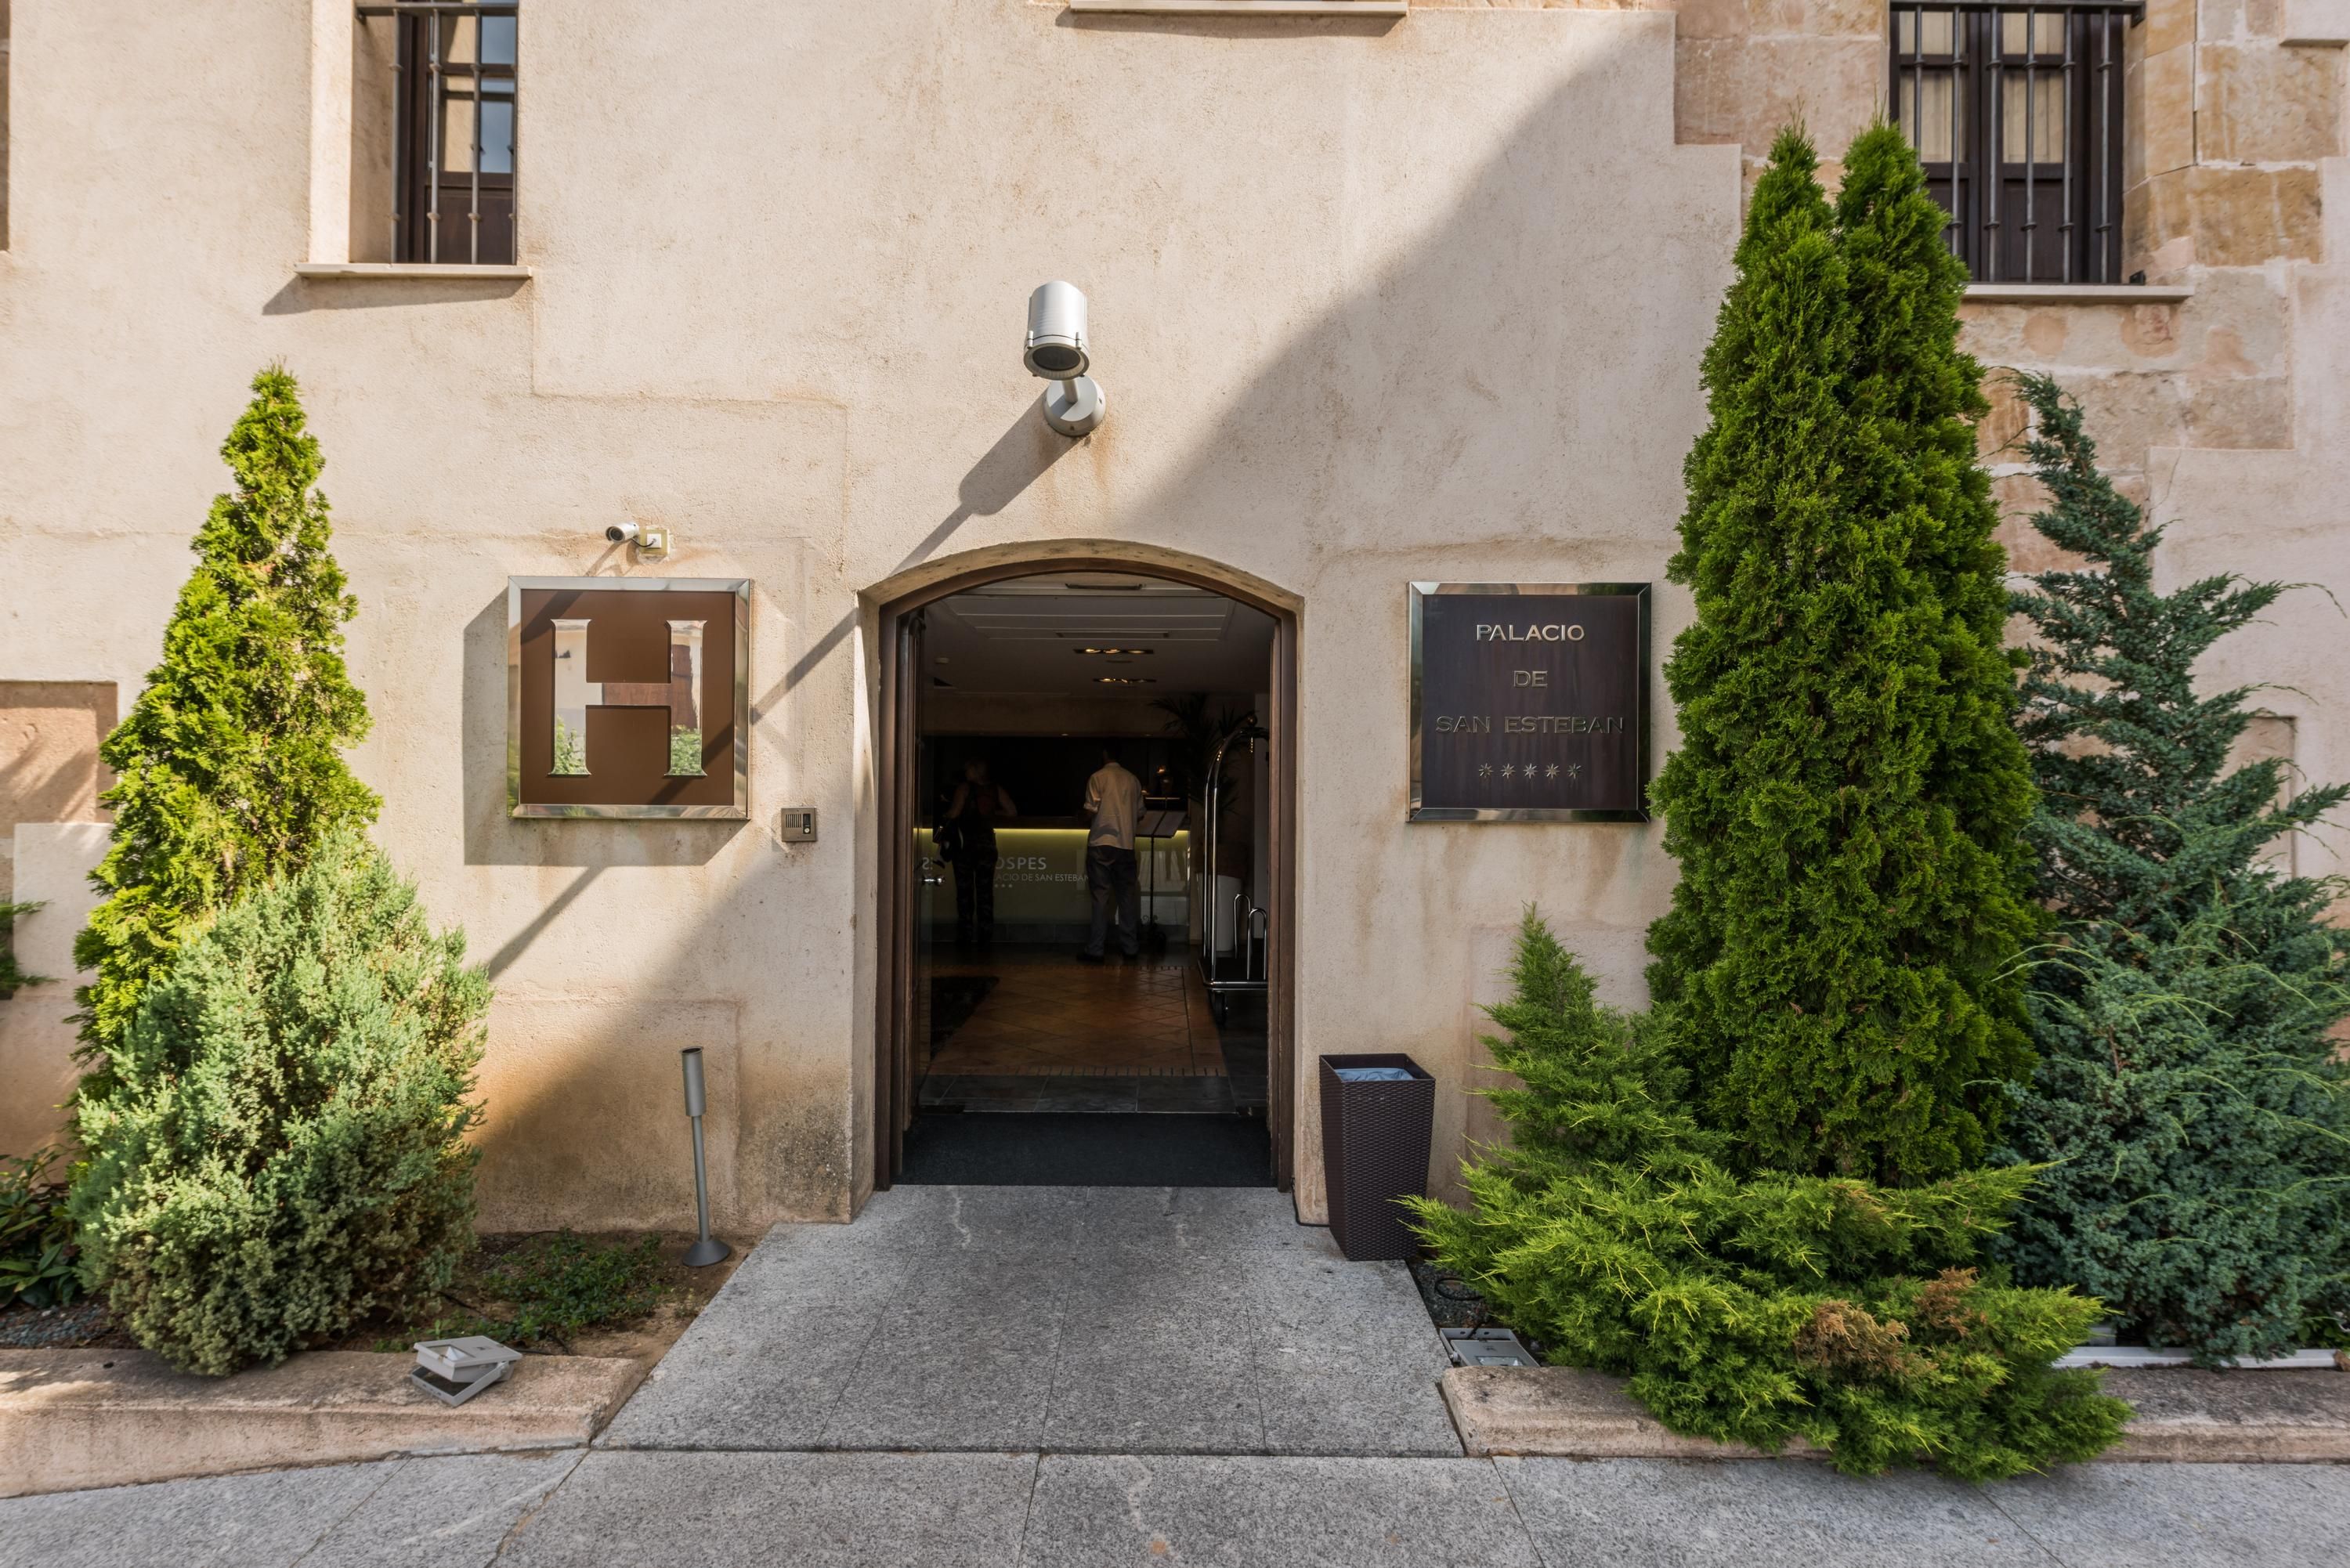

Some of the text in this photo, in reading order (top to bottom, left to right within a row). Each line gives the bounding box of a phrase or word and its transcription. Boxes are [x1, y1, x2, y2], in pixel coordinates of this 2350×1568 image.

[1476, 623, 1585, 642] PALACIO
[1513, 670, 1549, 688] DE
[548, 619, 707, 776] H
[1435, 716, 1625, 734] SAN ESTEBAN
[995, 856, 1047, 870] OSPES
[1021, 873, 1033, 882] DE
[1034, 873, 1053, 882] SAN
